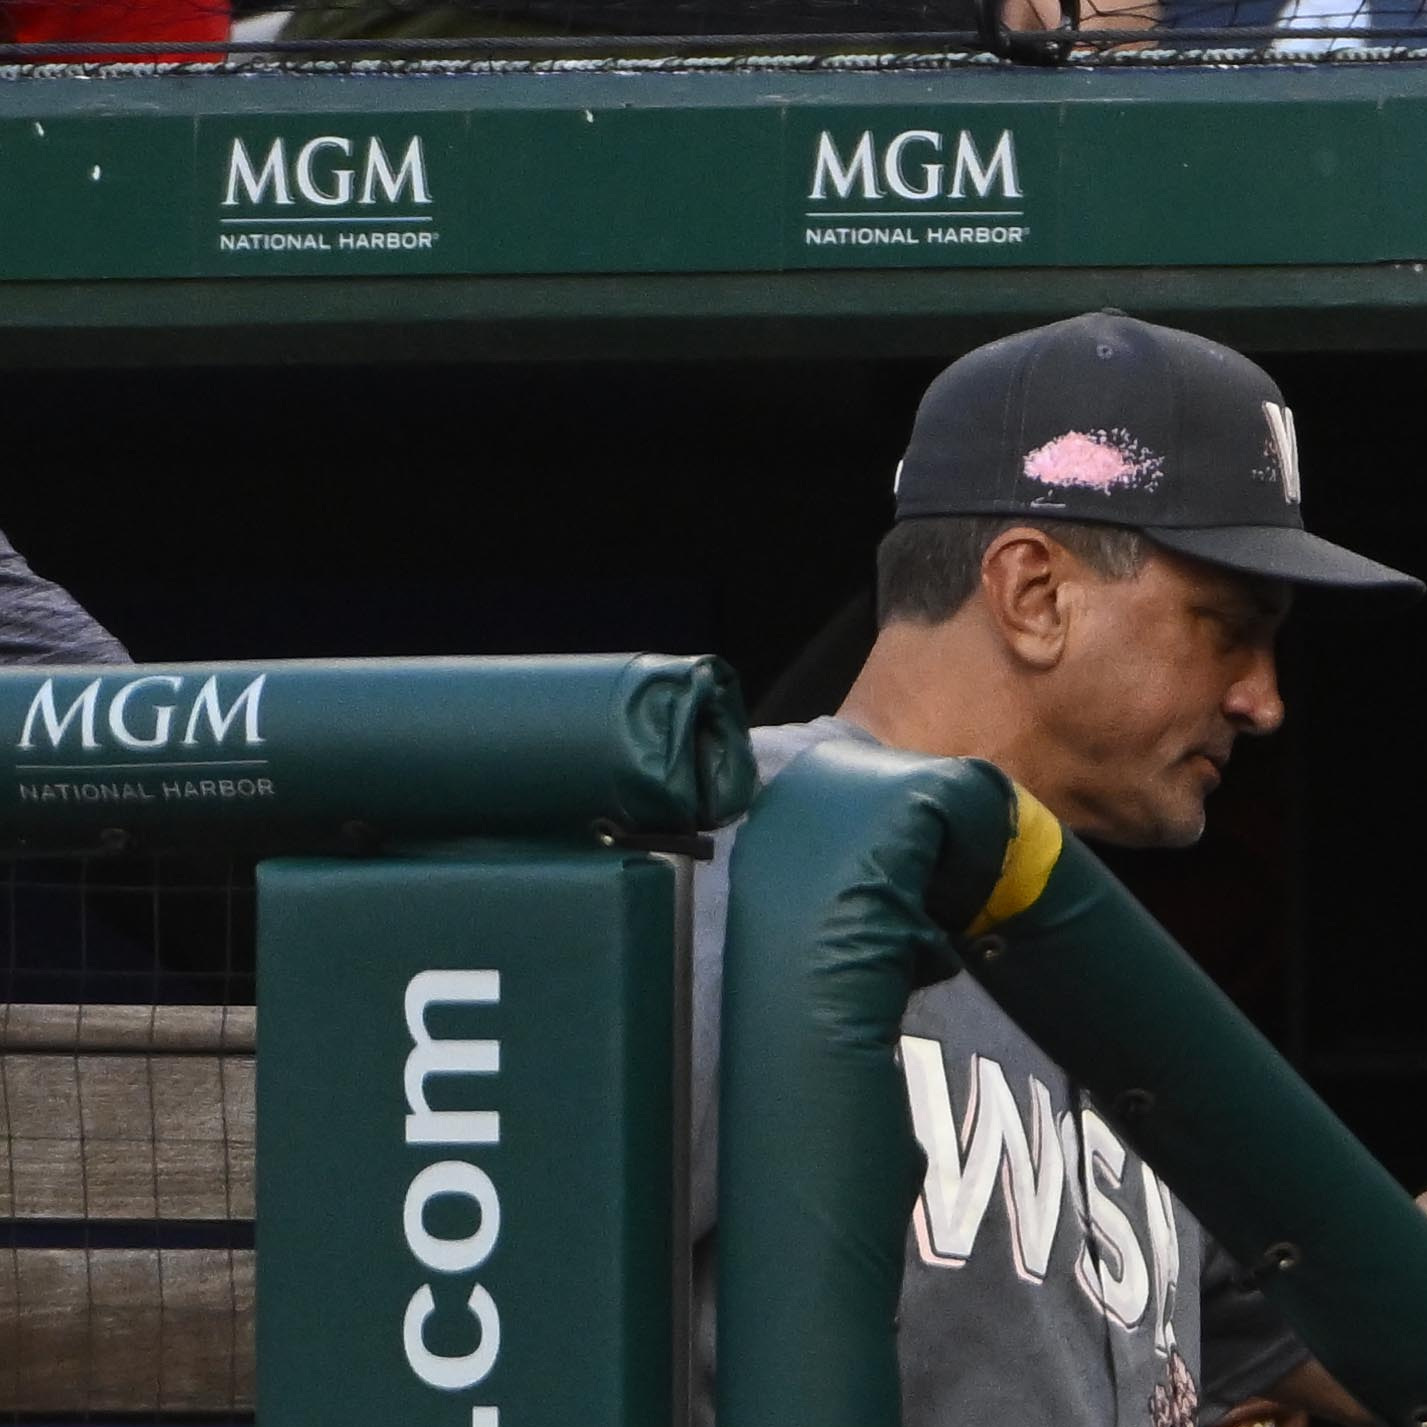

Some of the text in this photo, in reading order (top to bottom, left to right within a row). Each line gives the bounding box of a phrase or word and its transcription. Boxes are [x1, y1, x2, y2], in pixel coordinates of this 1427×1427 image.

[221, 135, 432, 206] MGM
[809, 129, 1023, 200] MGM
[220, 233, 331, 251] NATIONAL
[805, 227, 919, 245] NATIONAL
[17, 673, 268, 751] MGM
[19, 777, 275, 801] NATIONAL HARBOR
